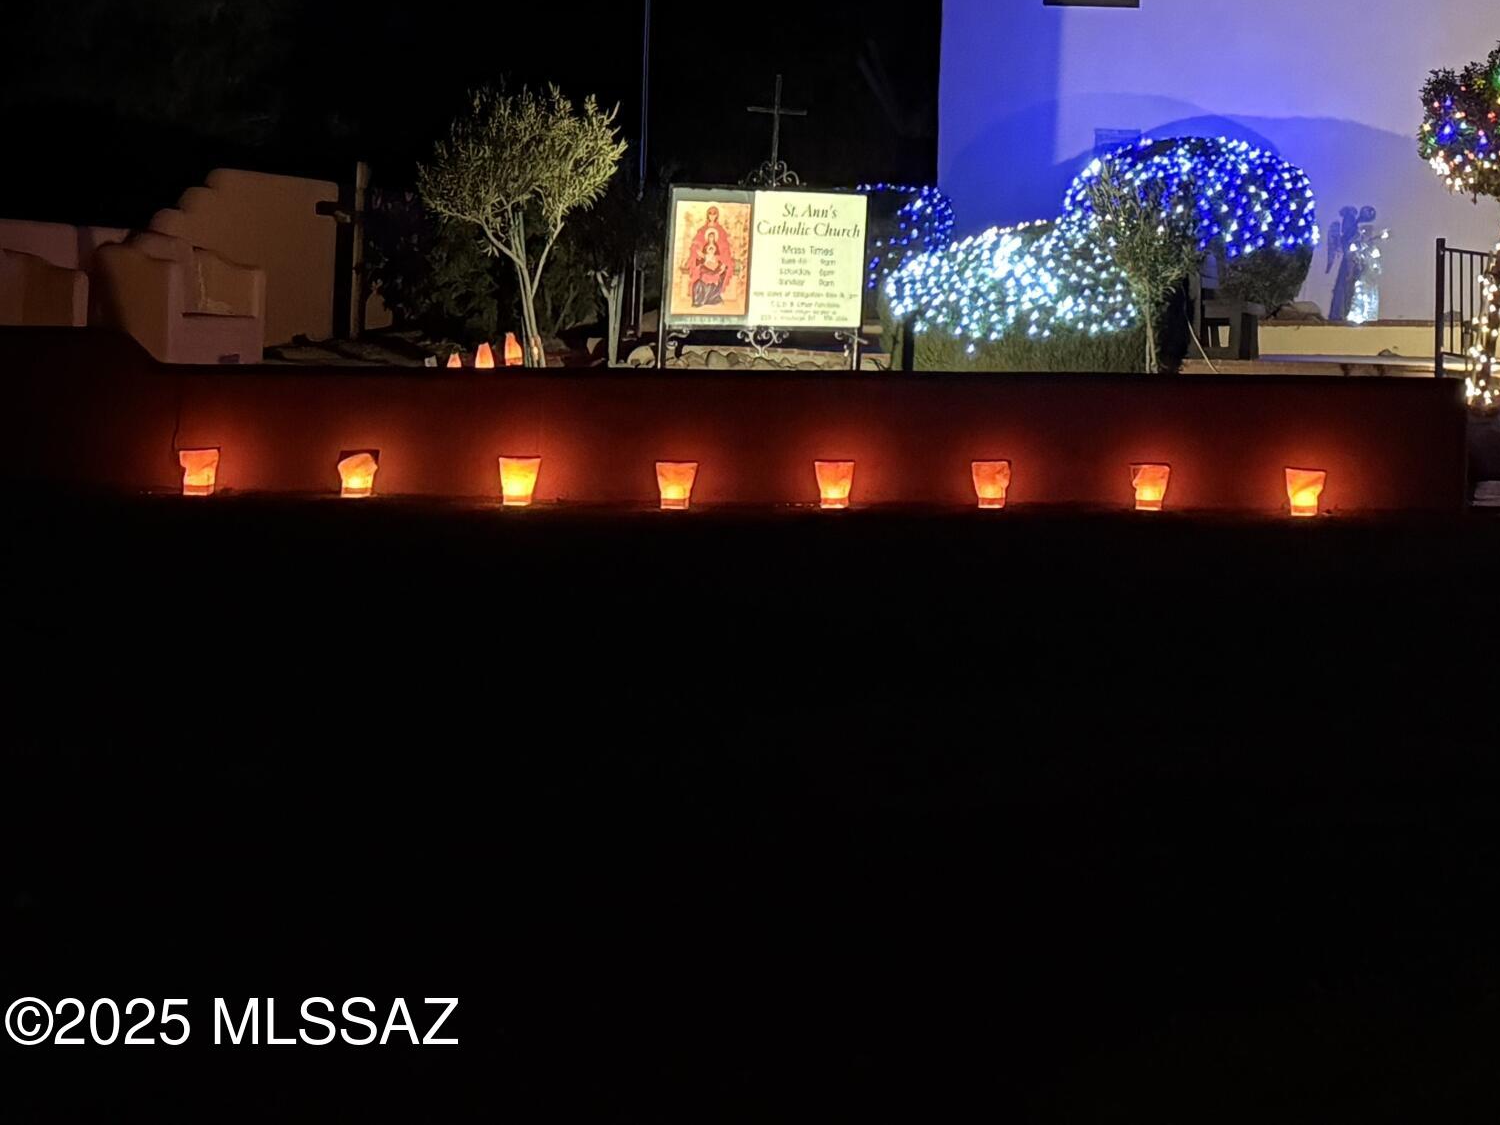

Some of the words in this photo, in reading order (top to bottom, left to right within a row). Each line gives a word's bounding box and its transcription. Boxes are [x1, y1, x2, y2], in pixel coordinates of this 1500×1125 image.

[782, 202, 798, 218] St.
[801, 203, 838, 219] Ann's
[757, 219, 810, 236] Catholic
[814, 221, 860, 238] Church
[782, 244, 806, 255] Mass
[809, 245, 834, 256] Times
